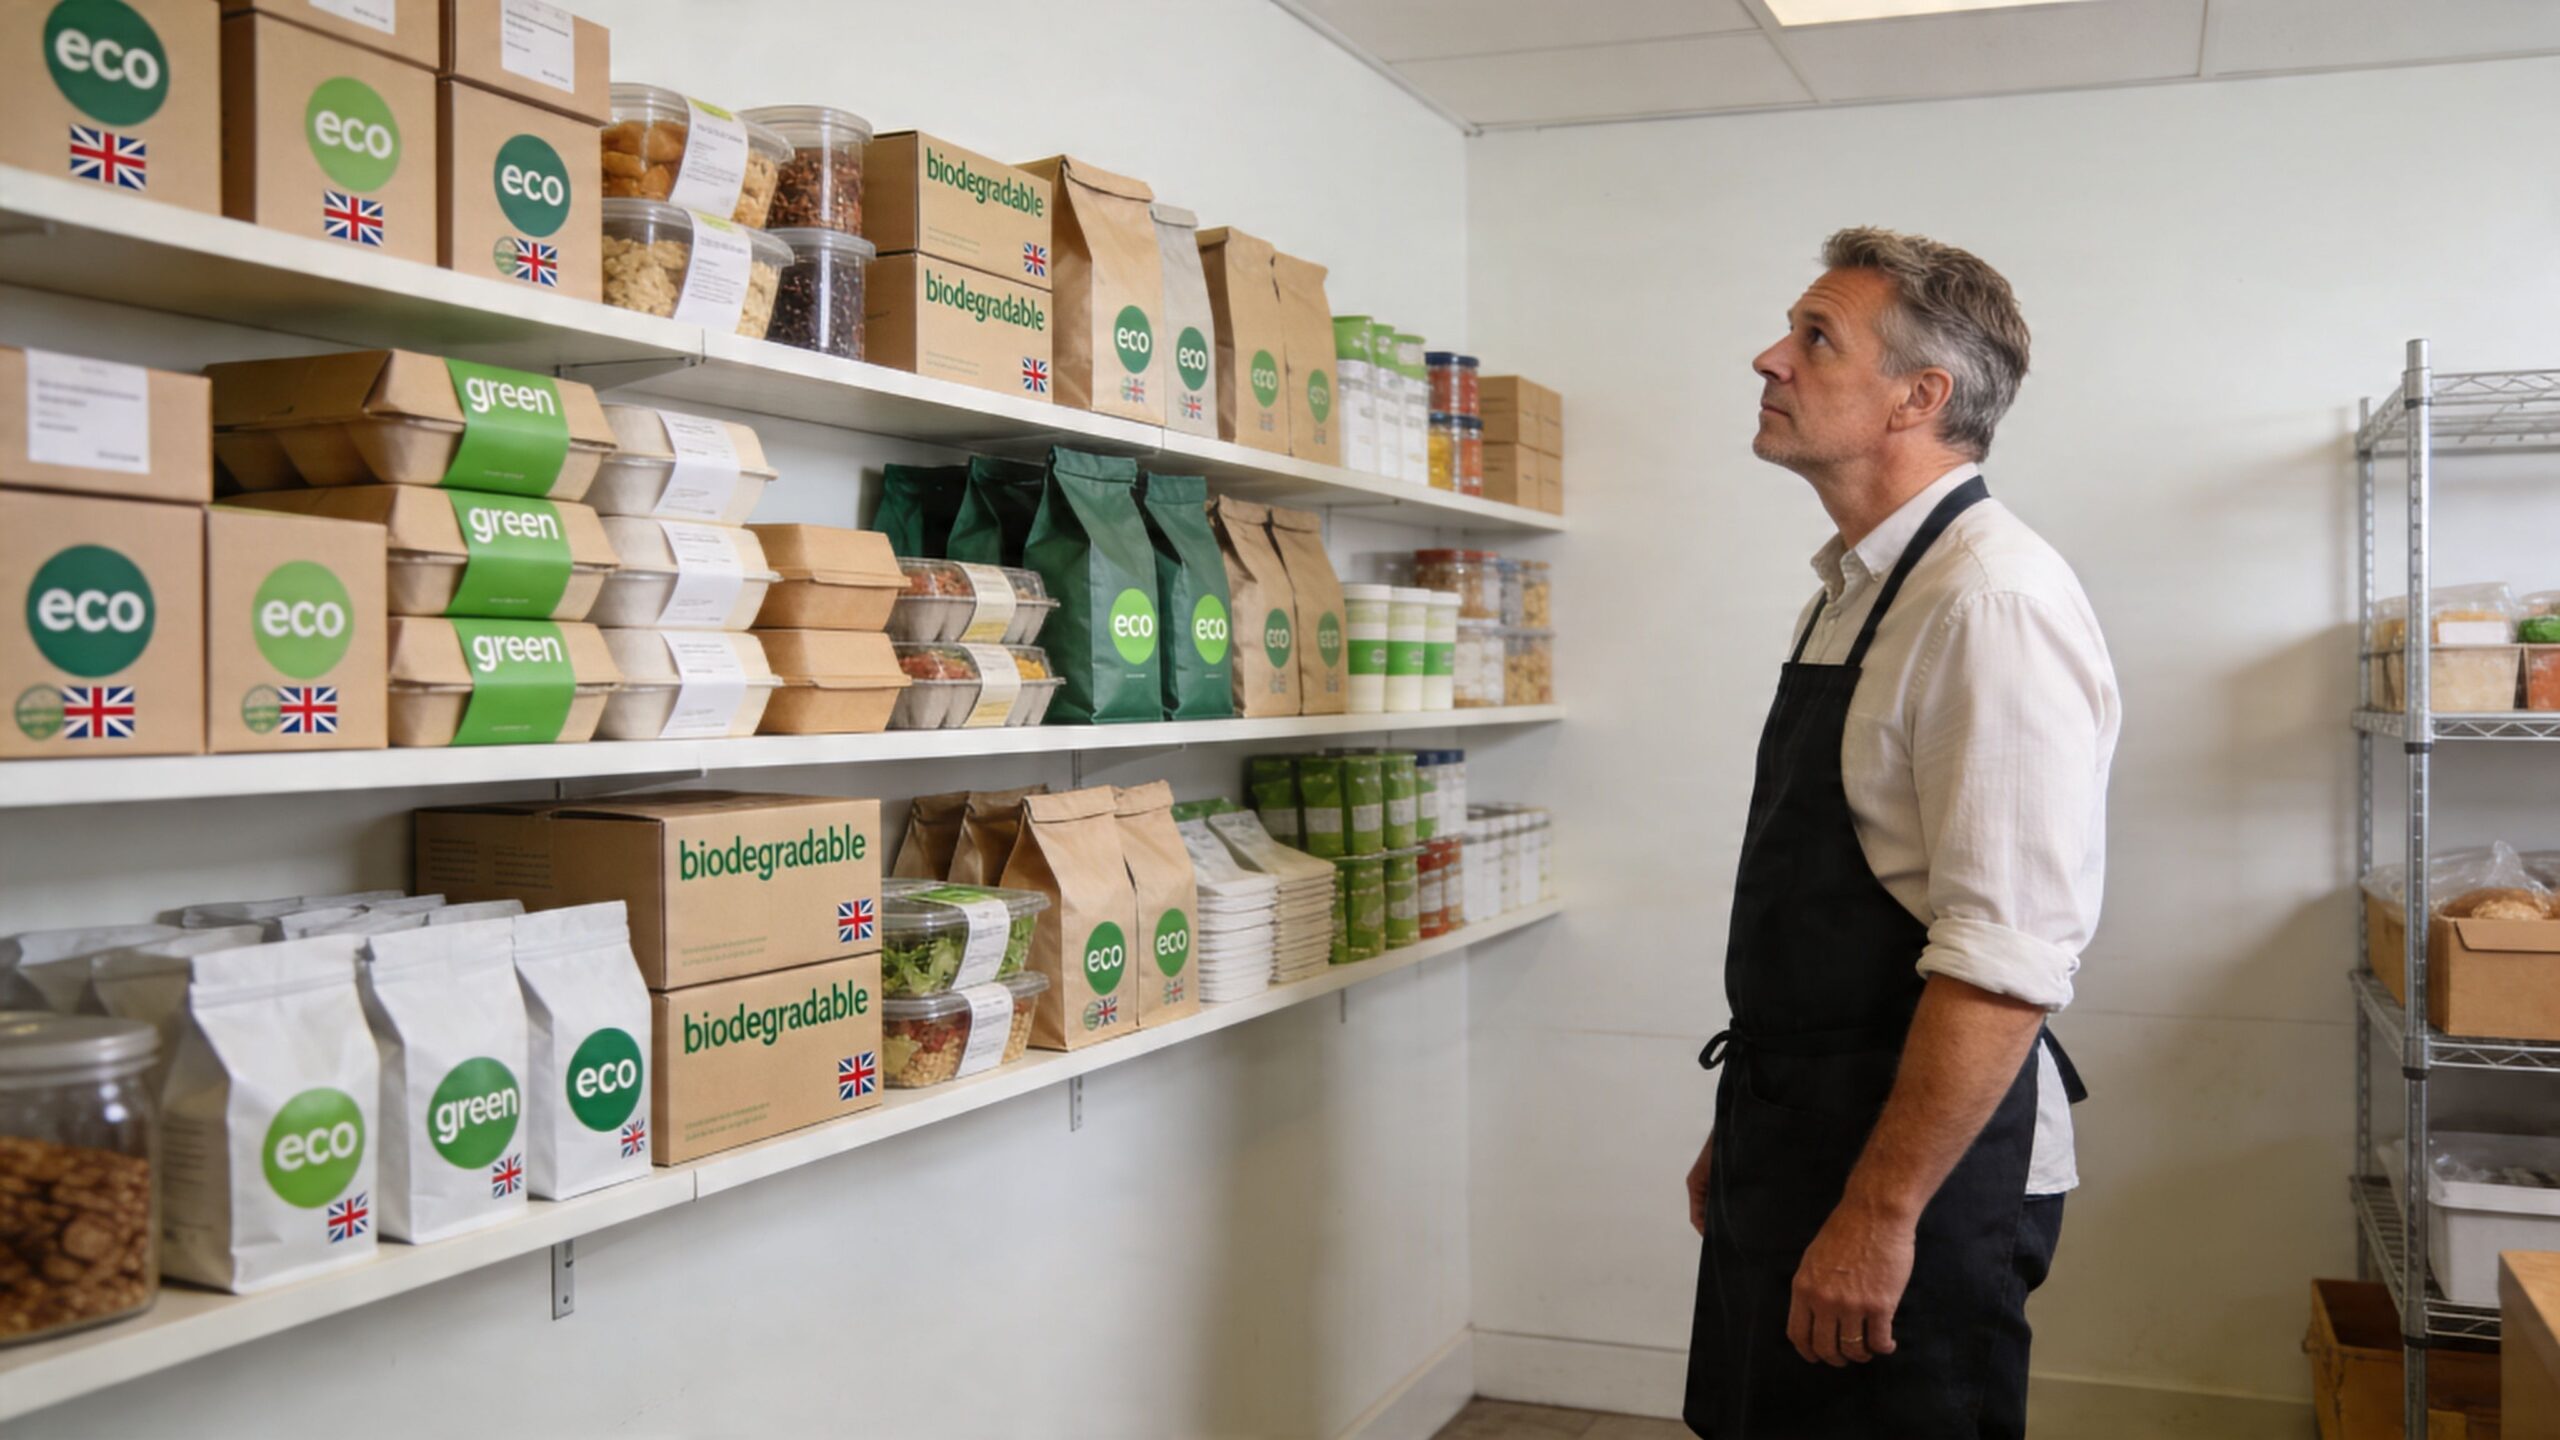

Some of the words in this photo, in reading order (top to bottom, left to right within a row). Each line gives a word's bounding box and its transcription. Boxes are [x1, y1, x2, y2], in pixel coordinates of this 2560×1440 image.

[56, 28, 159, 89] eco
[314, 110, 392, 160] eco
[502, 165, 563, 206] eco
[926, 147, 1044, 218] biodegradable
[926, 269, 1045, 332] biodegradable
[1117, 327, 1149, 354] eco
[1178, 345, 1206, 371] eco
[465, 376, 555, 416] green
[1252, 367, 1276, 390] eco
[469, 503, 559, 544] green
[39, 589, 145, 632] eco
[262, 601, 345, 637] eco
[1114, 615, 1153, 638] eco
[1196, 618, 1226, 640] eco
[473, 632, 562, 672] green
[1266, 629, 1289, 648] eco
[680, 825, 865, 881] biodegradable
[1087, 944, 1122, 972] eco
[1157, 927, 1186, 955] eco
[684, 980, 868, 1054] biodegradable
[576, 1058, 636, 1098] eco
[435, 1087, 517, 1143] green
[275, 1121, 357, 1172] eco
